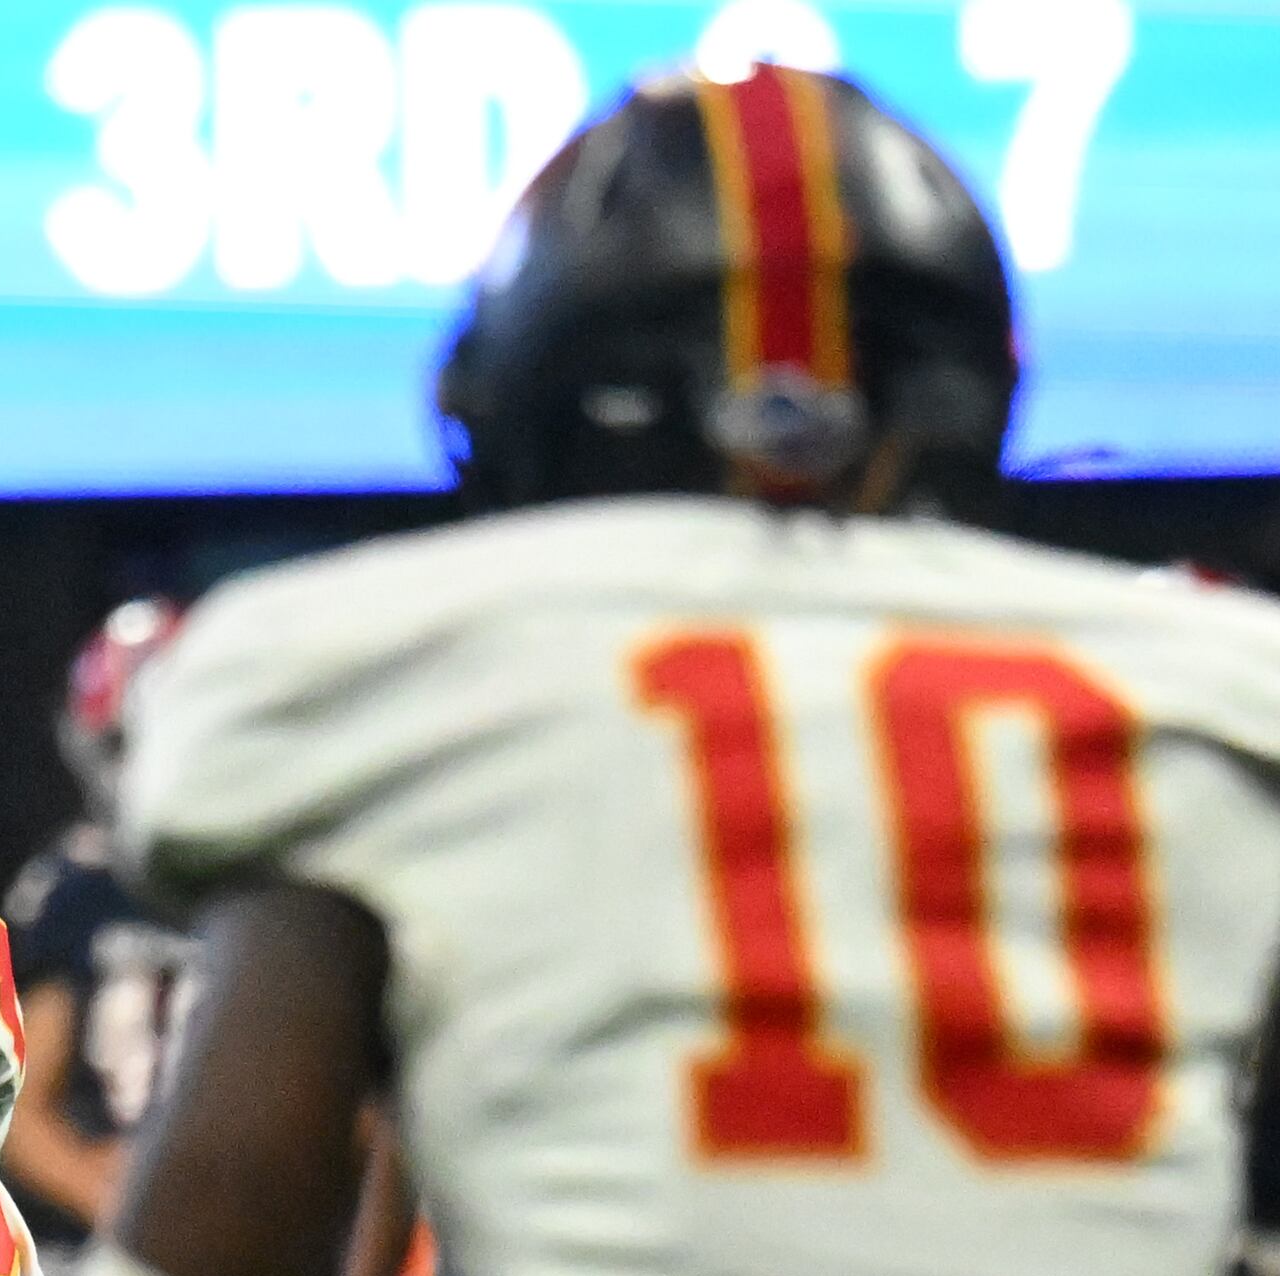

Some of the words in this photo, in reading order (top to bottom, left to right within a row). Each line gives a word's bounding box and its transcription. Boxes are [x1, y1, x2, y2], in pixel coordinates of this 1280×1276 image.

[40, 3, 588, 298] 3RD
[954, 0, 1134, 273] 7
[622, 622, 1176, 1178] 10
